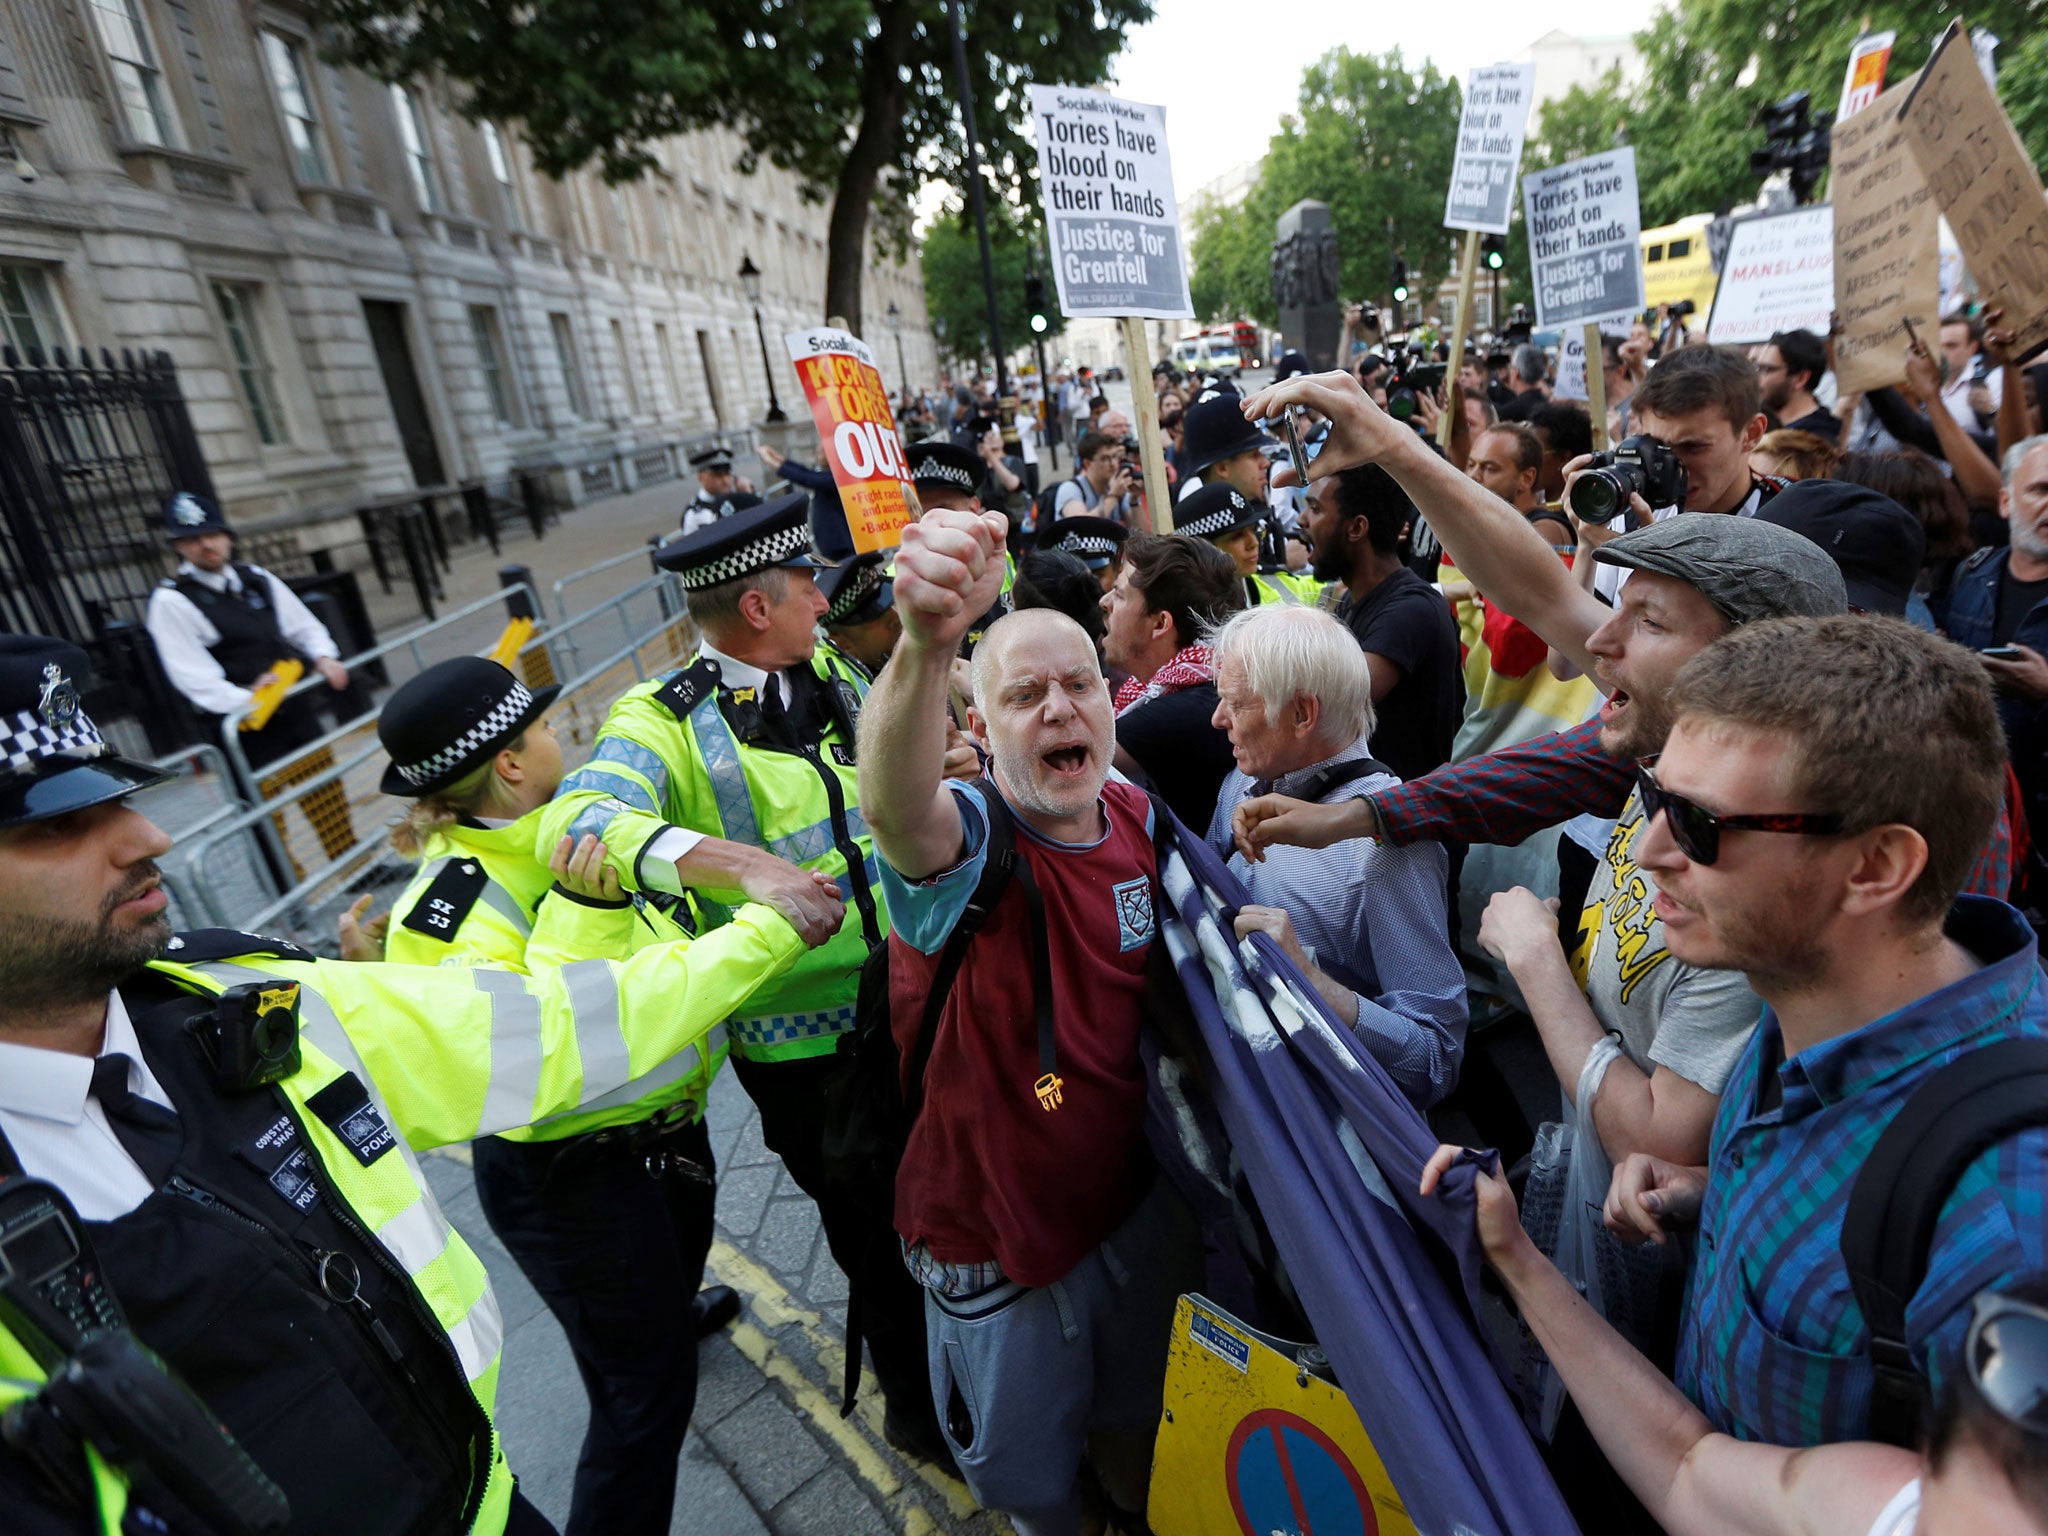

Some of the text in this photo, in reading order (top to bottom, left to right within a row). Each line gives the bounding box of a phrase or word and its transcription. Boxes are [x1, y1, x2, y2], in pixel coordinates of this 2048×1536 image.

[1057, 96, 1146, 122] Socialist Worker
[1496, 83, 1521, 104] have
[1042, 113, 1157, 155] Tories have
[1489, 111, 1502, 129] on
[1481, 132, 1513, 154] hands
[1047, 147, 1137, 182] blood on
[1580, 160, 1614, 177] Worker
[1051, 181, 1164, 218] their hands
[1531, 175, 1623, 213] Tories have
[1533, 205, 1601, 237] blood on
[1061, 221, 1167, 257] Justice for
[1535, 219, 1626, 259] their hands
[1065, 253, 1148, 286] Grenfell
[1541, 256, 1595, 287] Justice
[1601, 251, 1626, 274] for
[1543, 274, 1606, 309] Grenfell
[806, 356, 865, 390] KICK
[833, 421, 912, 481] OUT!
[862, 504, 881, 517] and
[866, 520, 891, 534] Back
[427, 913, 451, 929] 33
[1214, 1336, 1240, 1357] POLICE
